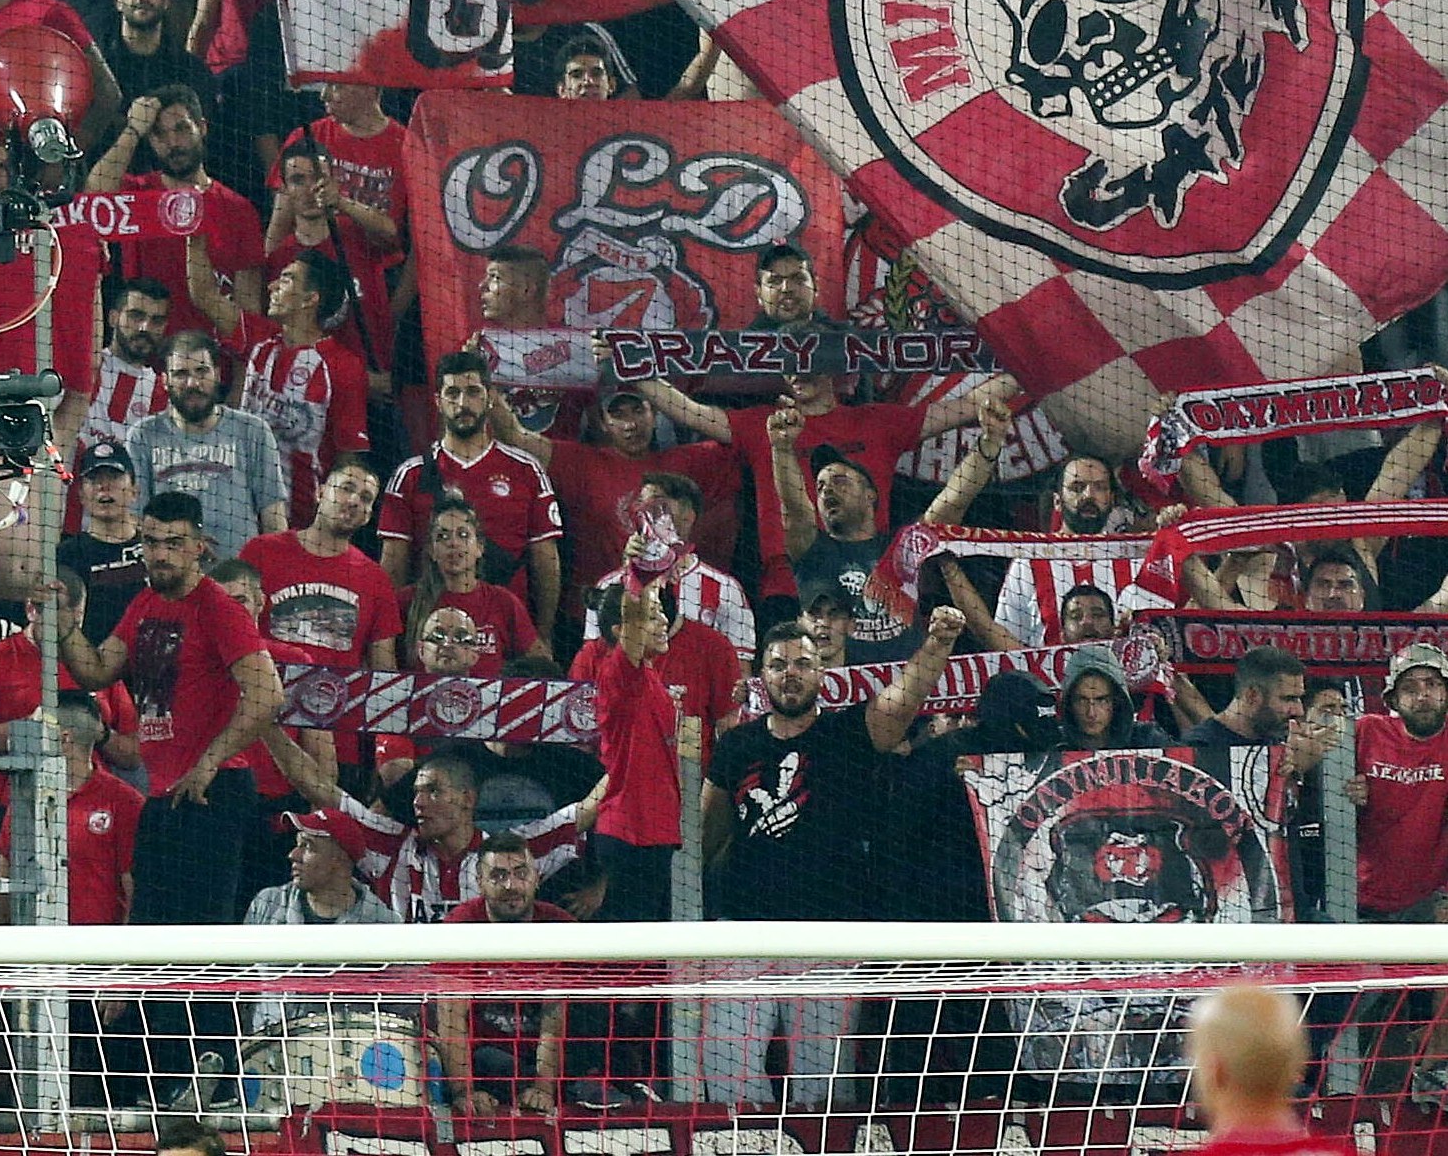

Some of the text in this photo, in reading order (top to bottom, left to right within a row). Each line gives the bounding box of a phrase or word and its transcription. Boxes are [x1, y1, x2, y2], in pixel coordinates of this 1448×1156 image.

[609, 329, 819, 379] CRAZY
[1188, 373, 1448, 436] ΟΛΥΜΠΙΑΚΟ
[1184, 622, 1448, 662] ΟΛΥΜΠΙΑΚΟ
[1015, 755, 1255, 845] ΟΛΥΜΠΙΑΚΟΣ
